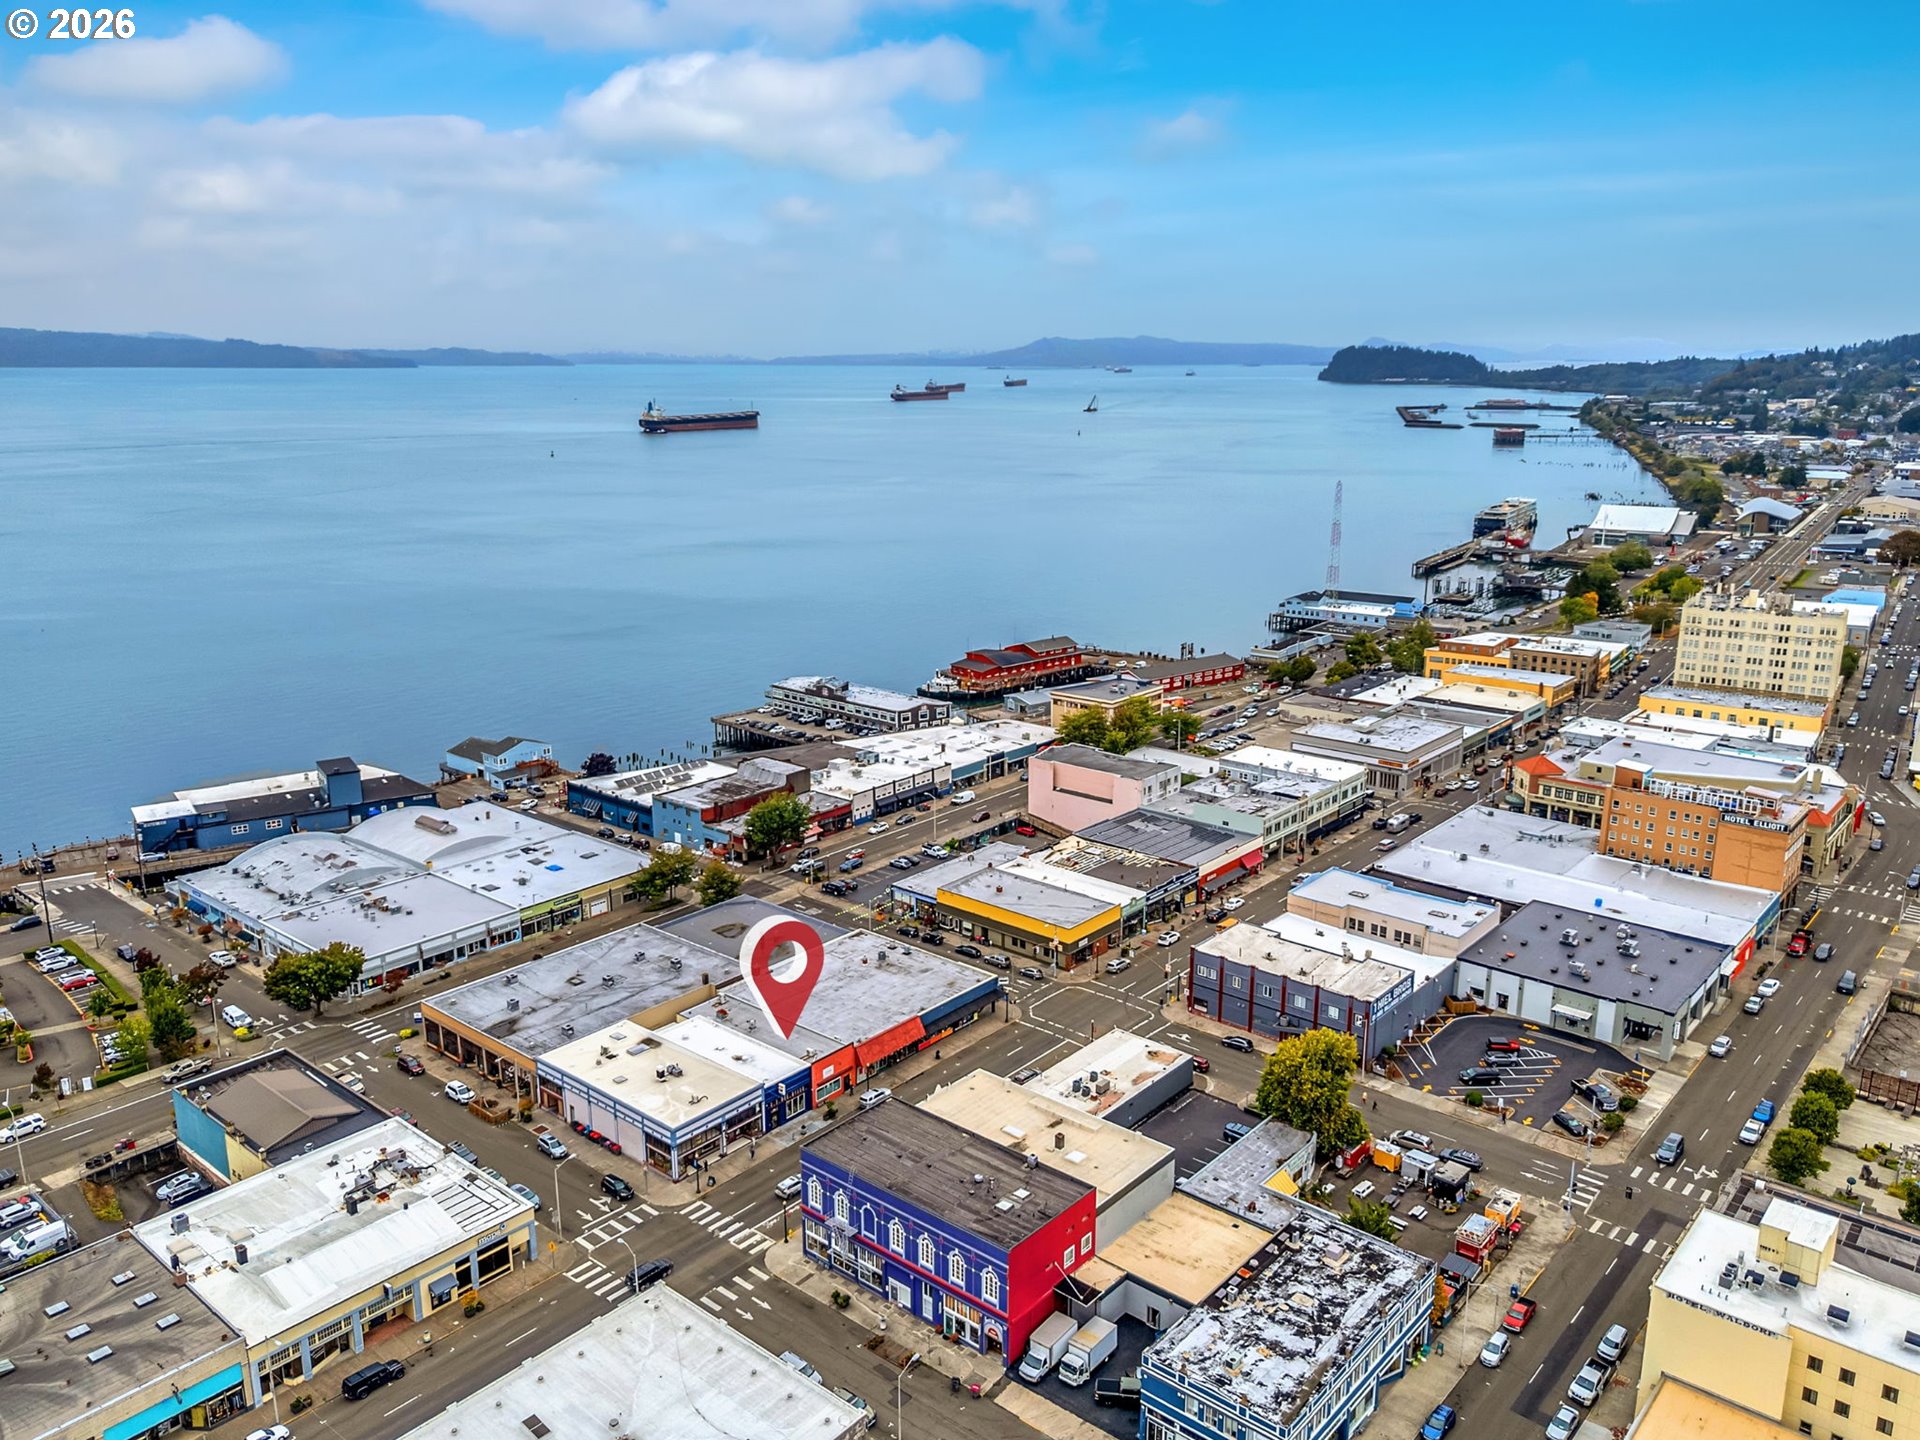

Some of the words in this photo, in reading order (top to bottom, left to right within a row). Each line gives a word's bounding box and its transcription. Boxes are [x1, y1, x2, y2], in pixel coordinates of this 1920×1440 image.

[1724, 815, 1751, 826] HOTEL
[1754, 821, 1786, 832] ELLIOTT
[1665, 1291, 1707, 1312] HOTEL
[1715, 1310, 1778, 1338] WALDORF
